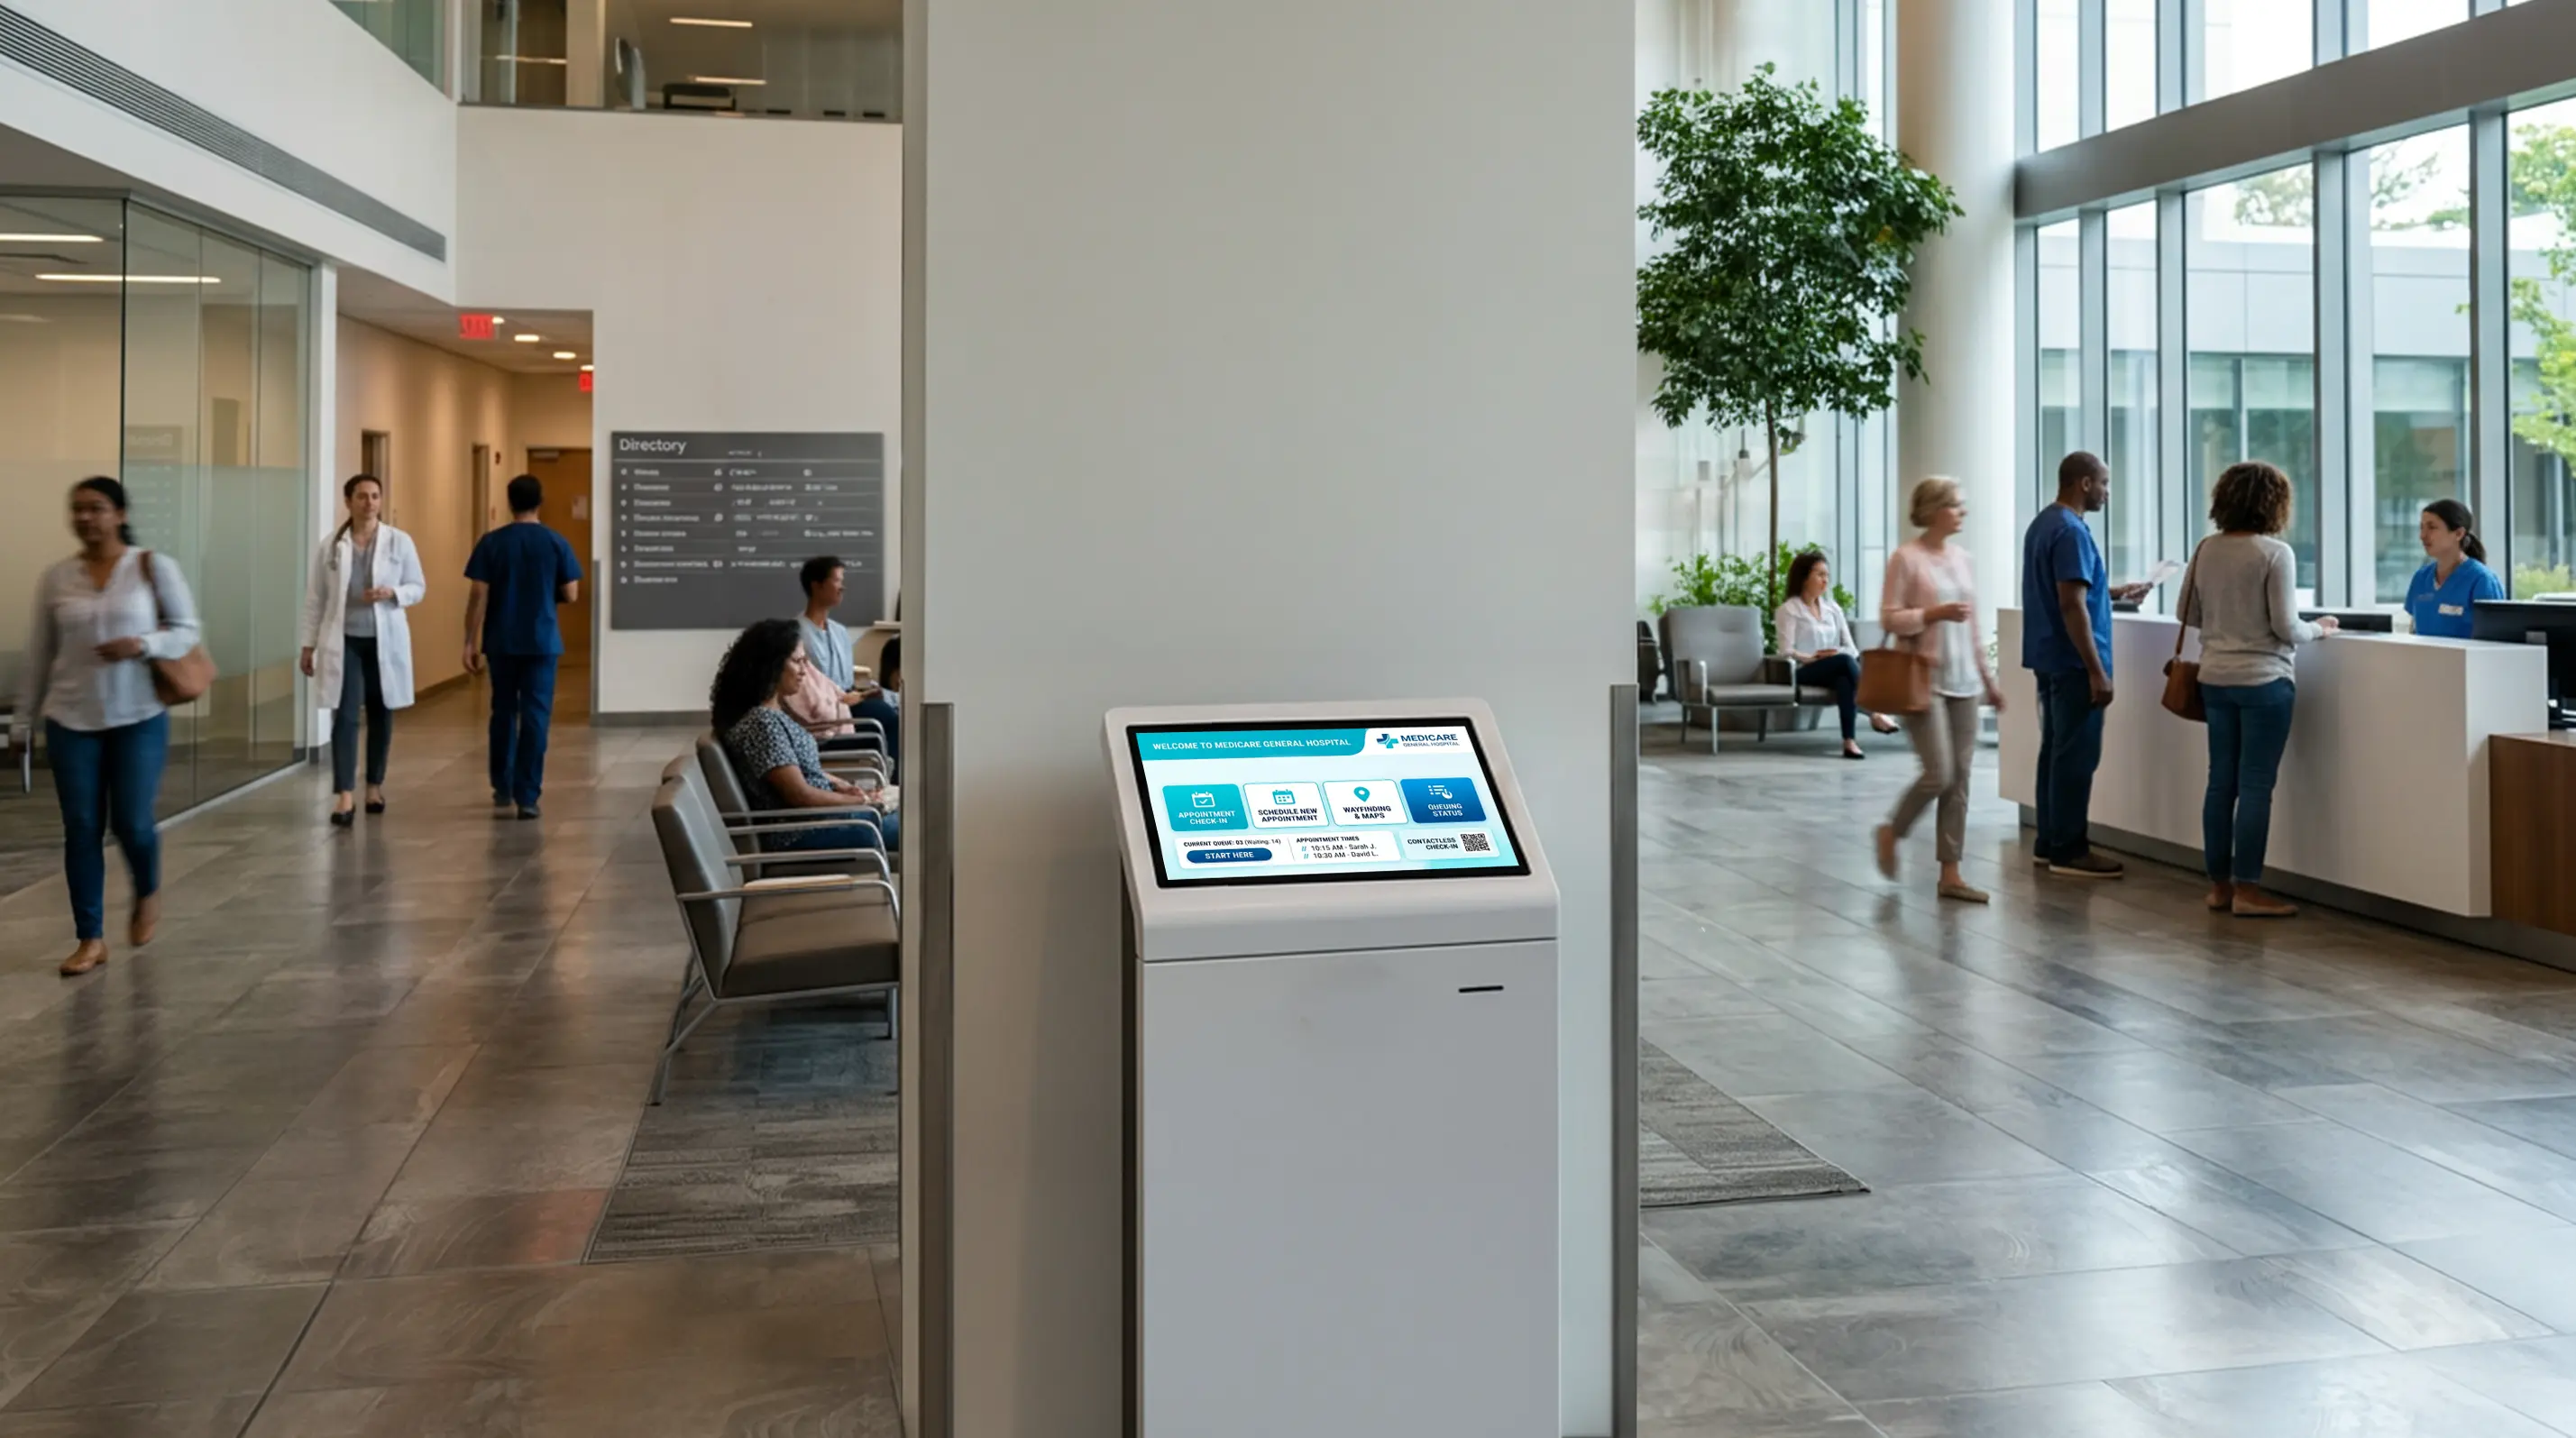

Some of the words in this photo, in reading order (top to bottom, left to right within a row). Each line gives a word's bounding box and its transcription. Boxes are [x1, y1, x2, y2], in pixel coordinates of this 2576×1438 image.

[619, 438, 687, 454] Directory
[1400, 733, 1458, 742] MEDICARE
[1152, 742, 1198, 750] WELCOME
[1200, 741, 1213, 749] TO
[1215, 740, 1261, 748] MEDICARE
[1263, 739, 1305, 747] GENERAL
[1306, 738, 1352, 746] HOSPITAL
[1258, 808, 1299, 816] SCHEDULE
[1343, 805, 1391, 813] WAYFINDING
[1178, 810, 1235, 819] APPOINTMENT
[1205, 851, 1231, 859] START
